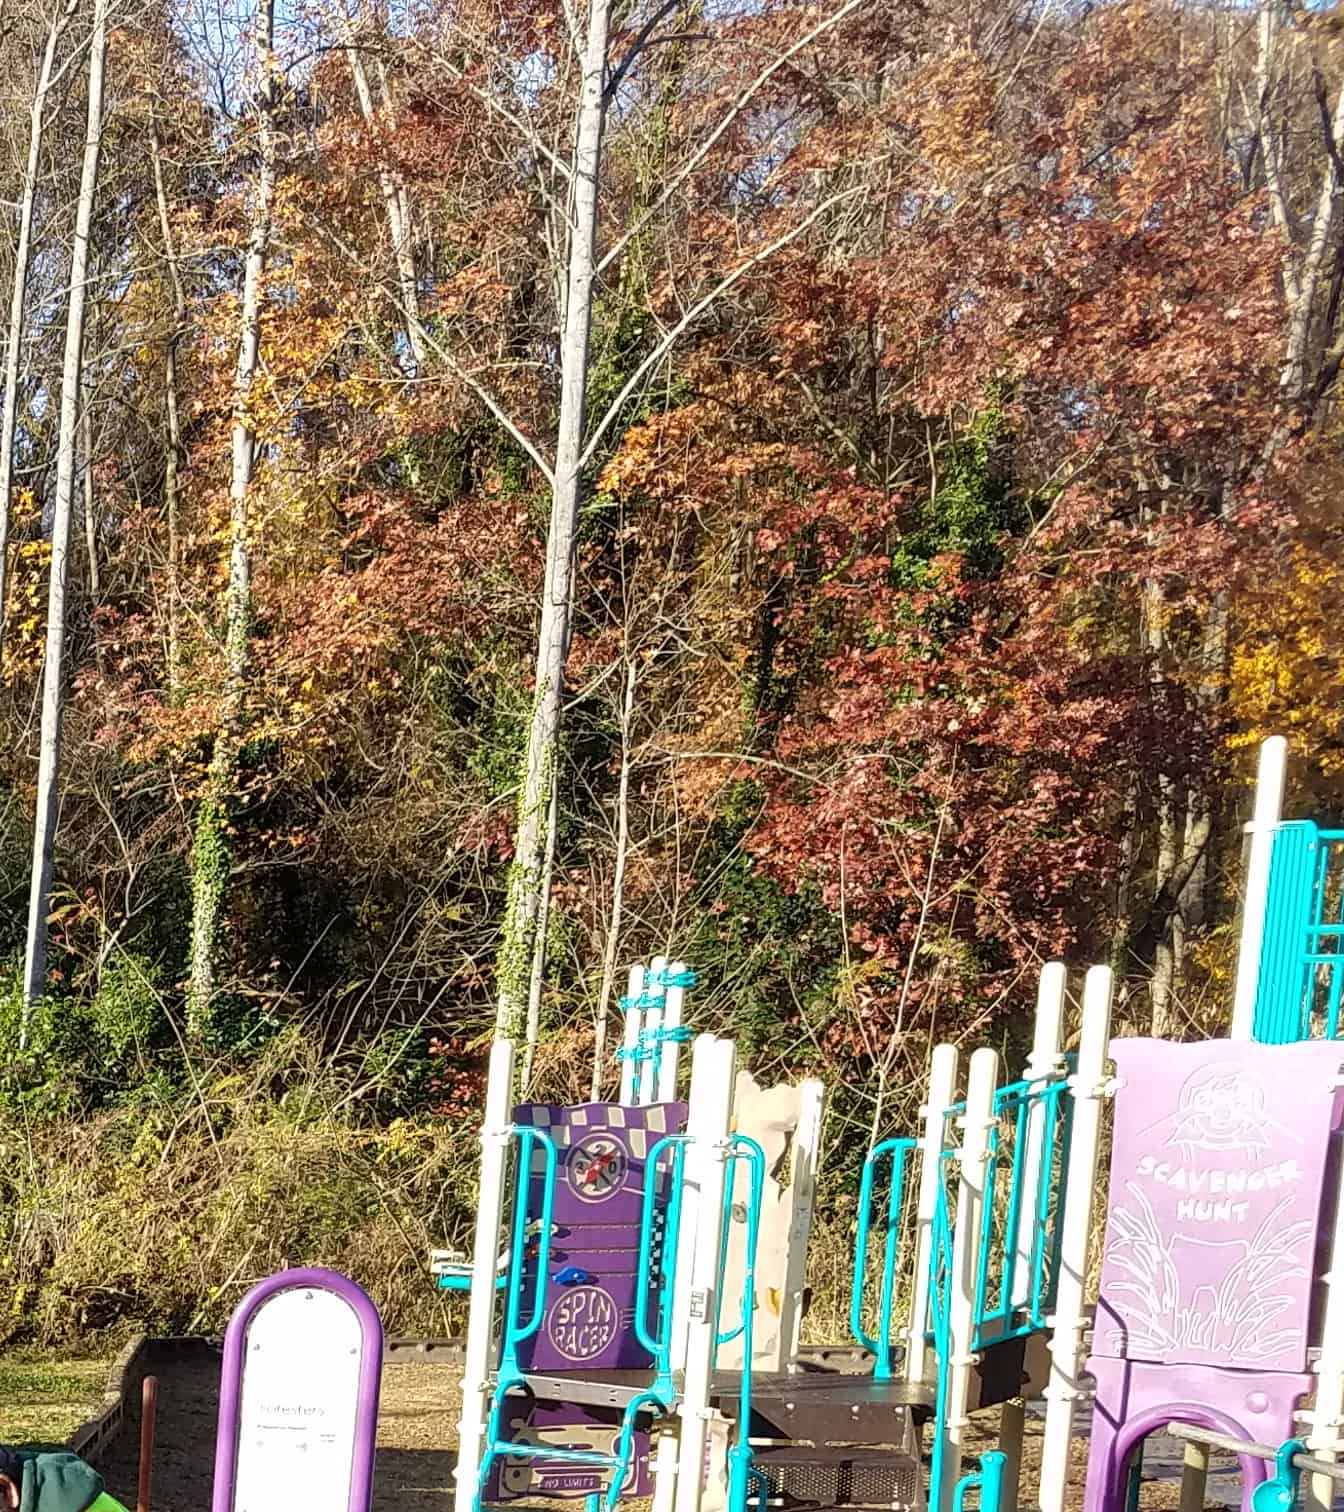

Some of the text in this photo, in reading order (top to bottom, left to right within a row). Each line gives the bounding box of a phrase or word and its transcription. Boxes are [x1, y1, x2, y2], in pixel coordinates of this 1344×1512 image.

[1136, 1155, 1302, 1194] SCAVENGER
[1177, 1200, 1249, 1224] HUNT
[558, 1291, 611, 1324] SPIN
[555, 1325, 610, 1355] RACER
[564, 1477, 595, 1488] LIMITS
